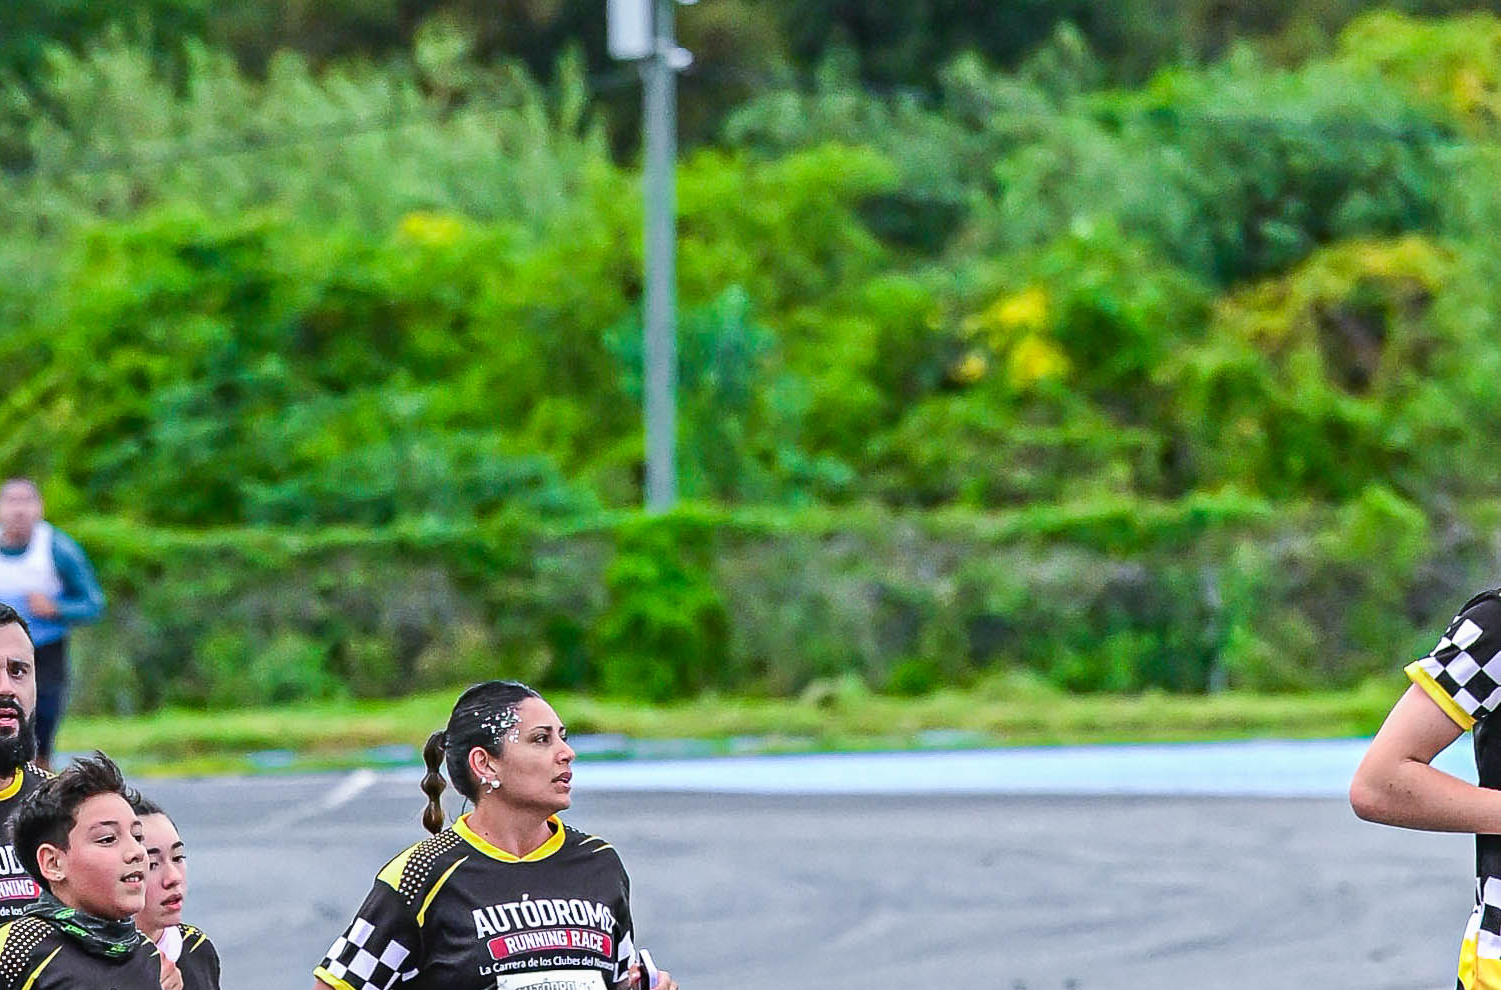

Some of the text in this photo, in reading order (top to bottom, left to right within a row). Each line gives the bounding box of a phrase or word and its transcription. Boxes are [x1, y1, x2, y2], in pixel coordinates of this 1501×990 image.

[0, 906, 10, 917] de
[11, 905, 23, 915] los
[472, 893, 615, 939] AUTÓDROMO
[504, 930, 603, 954] RUNNING RACE
[479, 966, 491, 975] La
[493, 959, 526, 973] Carrera
[528, 958, 539, 967] de
[540, 956, 552, 966] los
[553, 956, 580, 966] Clubes
[581, 956, 594, 966] del
